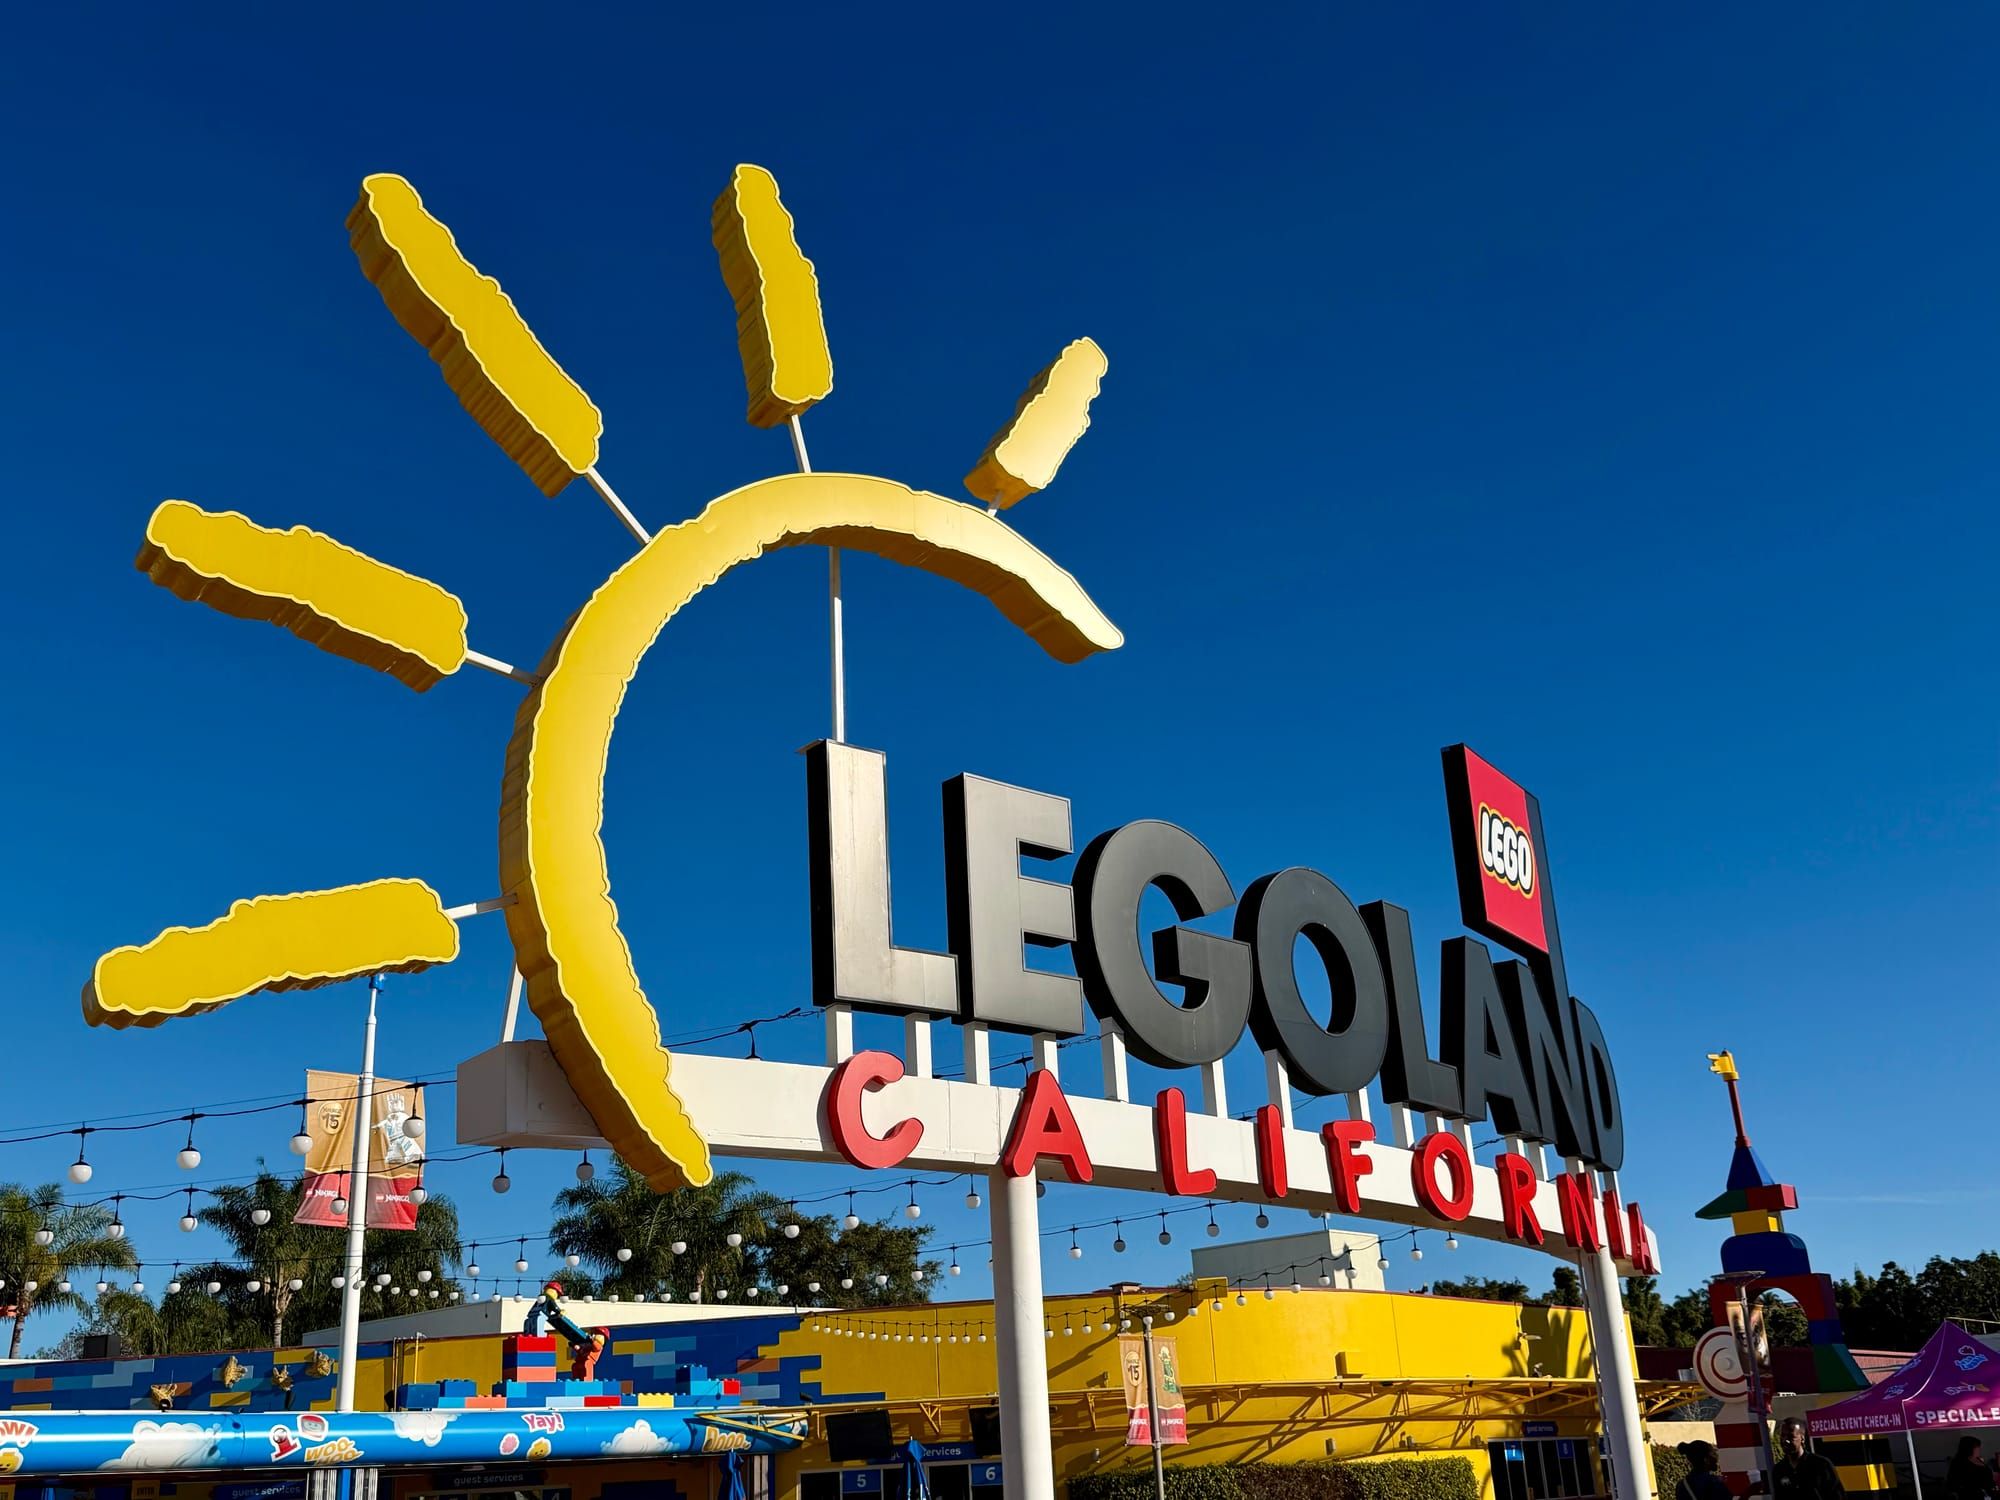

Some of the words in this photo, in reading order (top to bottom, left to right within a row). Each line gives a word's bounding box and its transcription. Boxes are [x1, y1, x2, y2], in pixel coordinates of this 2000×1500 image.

[1481, 811, 1532, 890] LEGO
[806, 739, 1623, 1171] LEGOLAND
[321, 1113, 340, 1129] 15
[827, 1050, 1655, 1273] CALIFORNIA
[1128, 1364, 1140, 1380] 15
[524, 1414, 563, 1432] Yay!
[1811, 1419, 1839, 1432] SPECIAL
[1840, 1416, 1863, 1430] EVENT
[1864, 1414, 1902, 1429] CHECK-IN
[1915, 1407, 1989, 1425] SPECIAL
[923, 1447, 961, 1457] ervices
[454, 1475, 481, 1487] guest
[486, 1472, 524, 1484] services
[856, 1474, 867, 1488] 5
[986, 1467, 996, 1481] 6
[231, 1488, 259, 1498] guest
[261, 1485, 301, 1496] services
